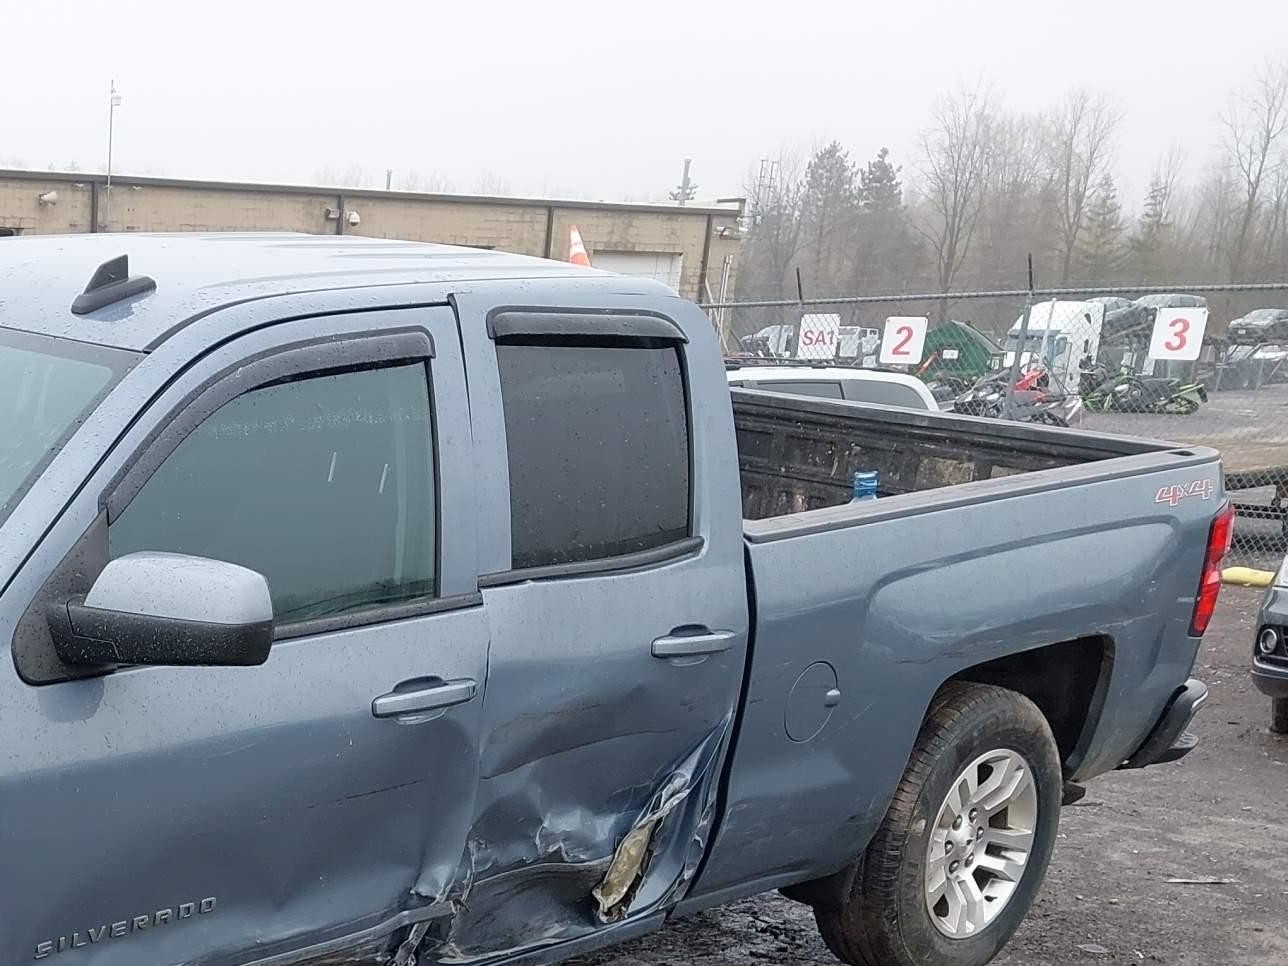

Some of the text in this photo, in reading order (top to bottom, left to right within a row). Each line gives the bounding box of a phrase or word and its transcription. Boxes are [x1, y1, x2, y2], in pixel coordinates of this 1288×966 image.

[892, 326, 914, 356] 2
[1164, 318, 1190, 351] 3
[34, 896, 217, 960] SILVERADO
